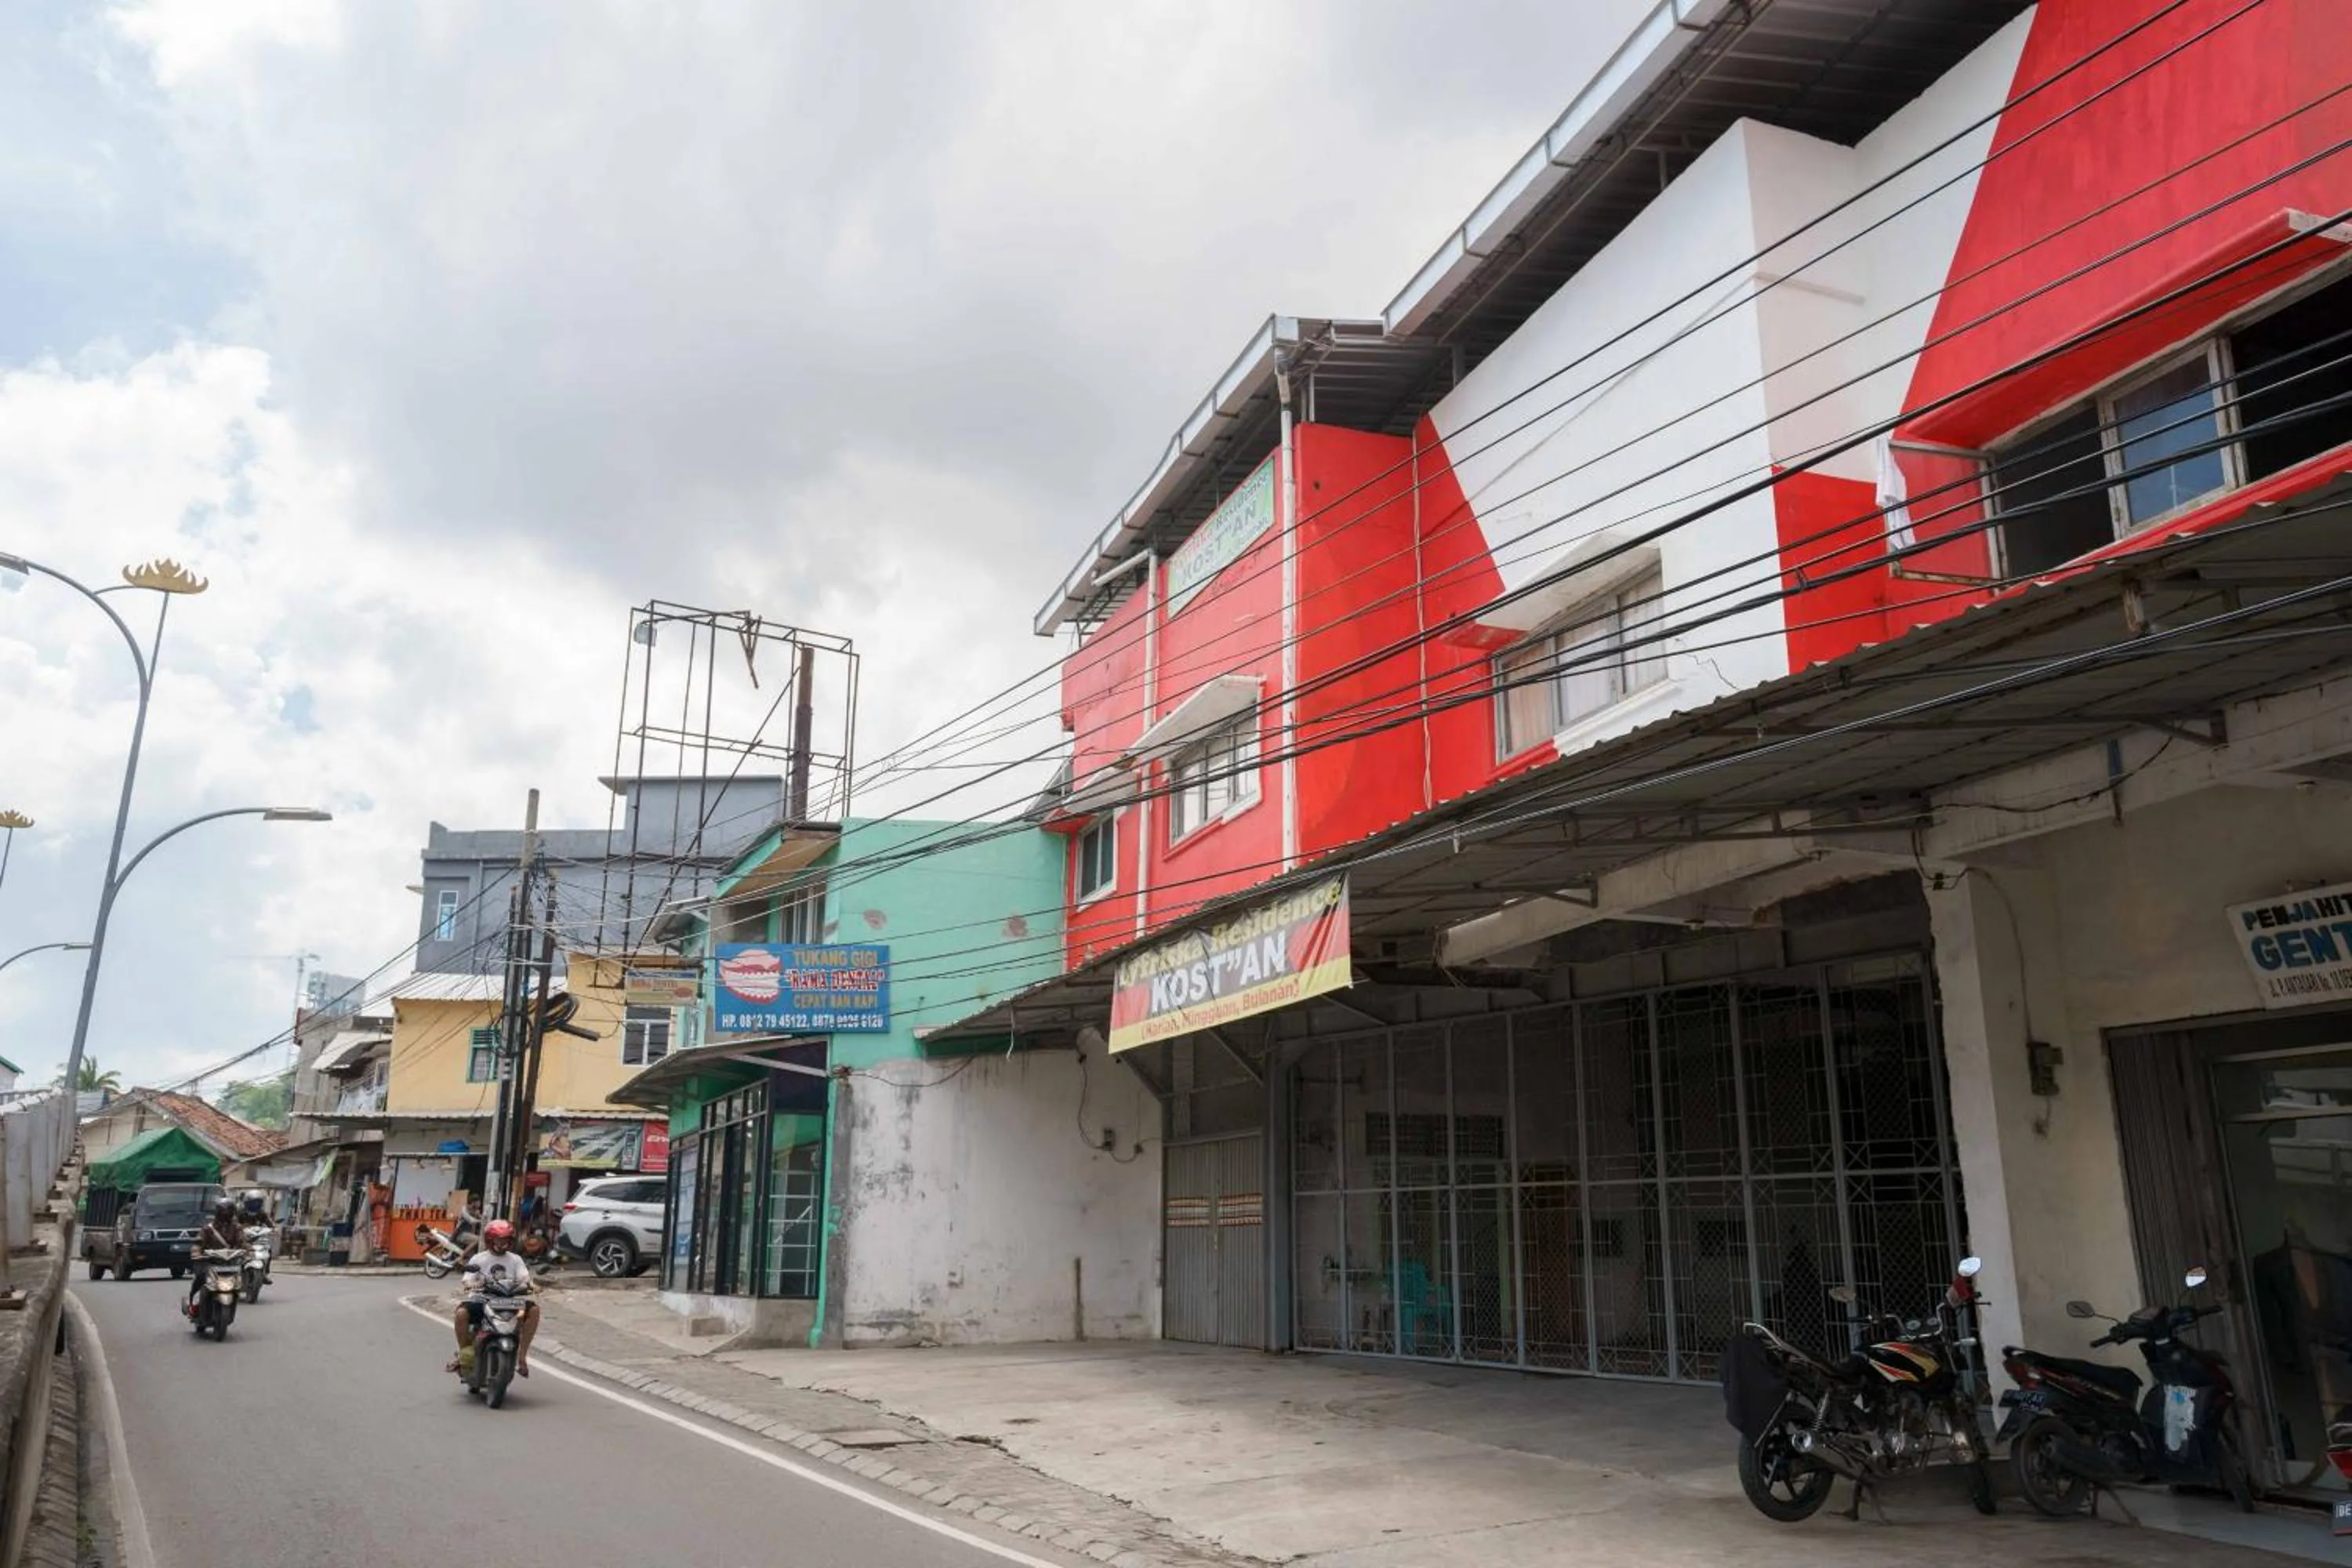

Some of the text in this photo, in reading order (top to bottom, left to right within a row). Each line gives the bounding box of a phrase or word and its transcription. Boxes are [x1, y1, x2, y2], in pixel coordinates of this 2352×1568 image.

[1210, 880, 1342, 953] Residence
[793, 949, 878, 968] TUKANG GIGI
